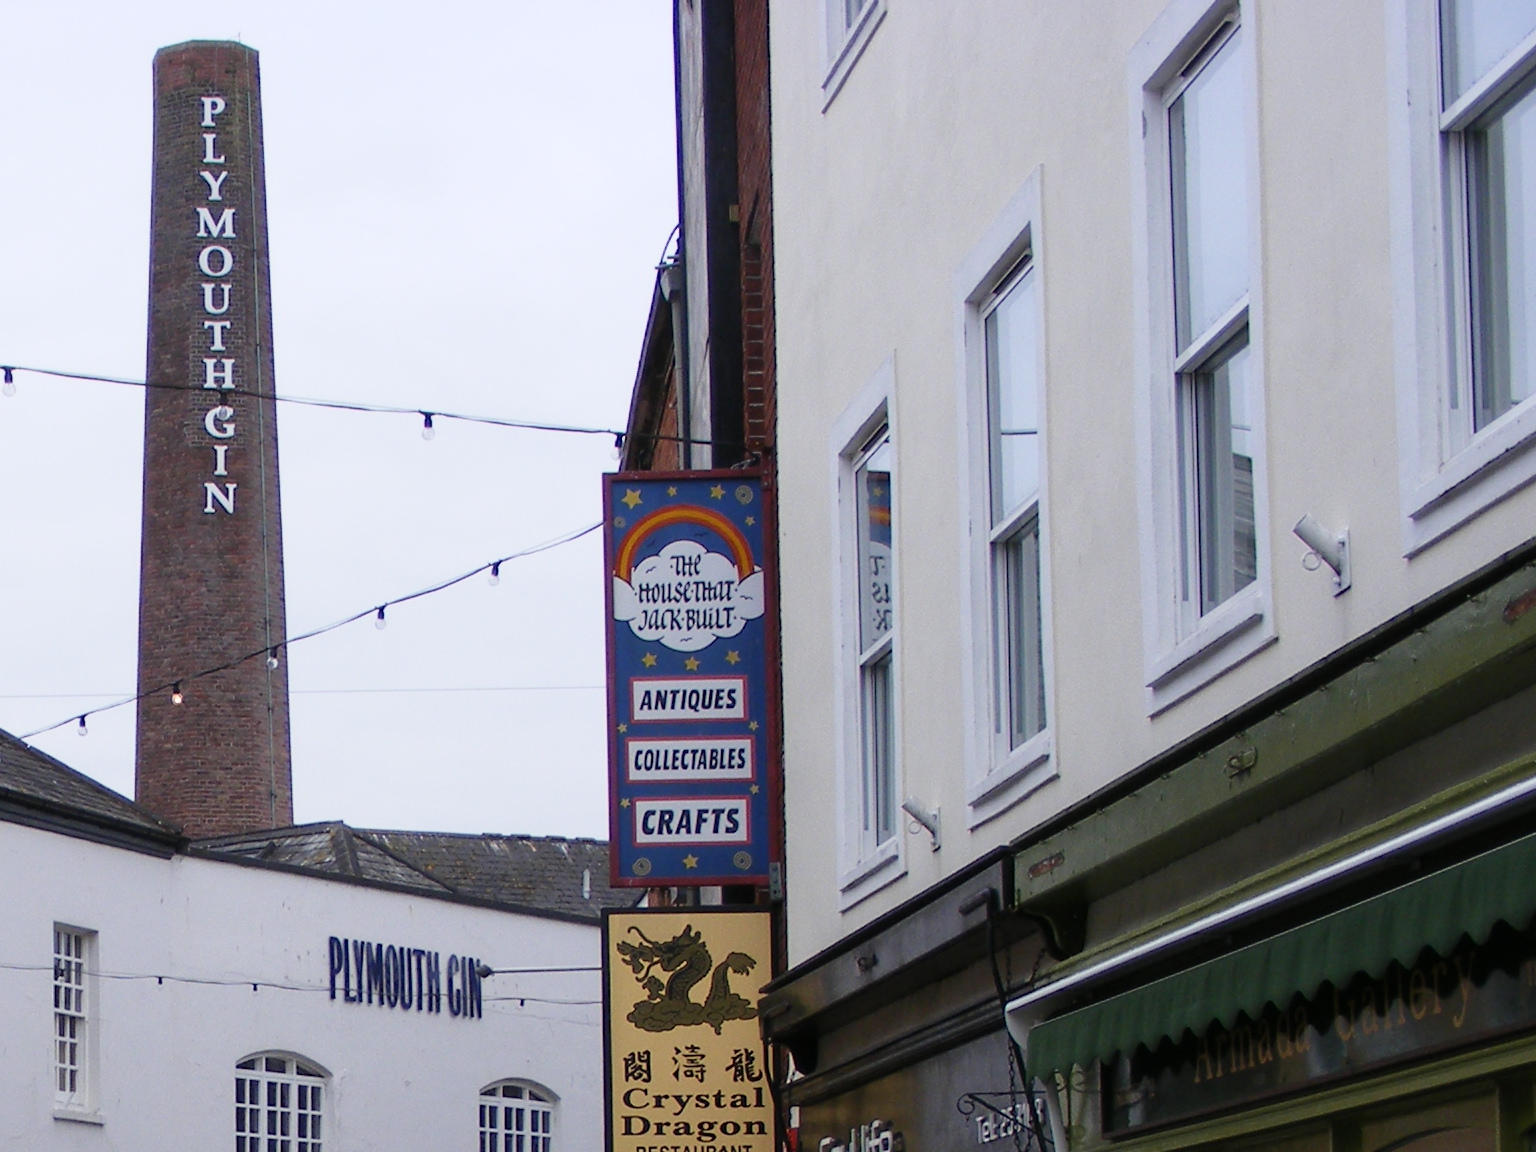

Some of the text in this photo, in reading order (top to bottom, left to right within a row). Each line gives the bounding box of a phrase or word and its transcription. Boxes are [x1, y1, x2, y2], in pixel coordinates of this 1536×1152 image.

[196, 96, 237, 515] PLYMOUTH GIN
[639, 688, 737, 712] ANTIQUES
[634, 748, 745, 771] COLLECTABLES
[642, 808, 739, 835] CRAFTS
[328, 936, 482, 1019] PLYMOUTH GIN
[622, 1087, 765, 1116] Crystal
[621, 1115, 767, 1142] Dragon
